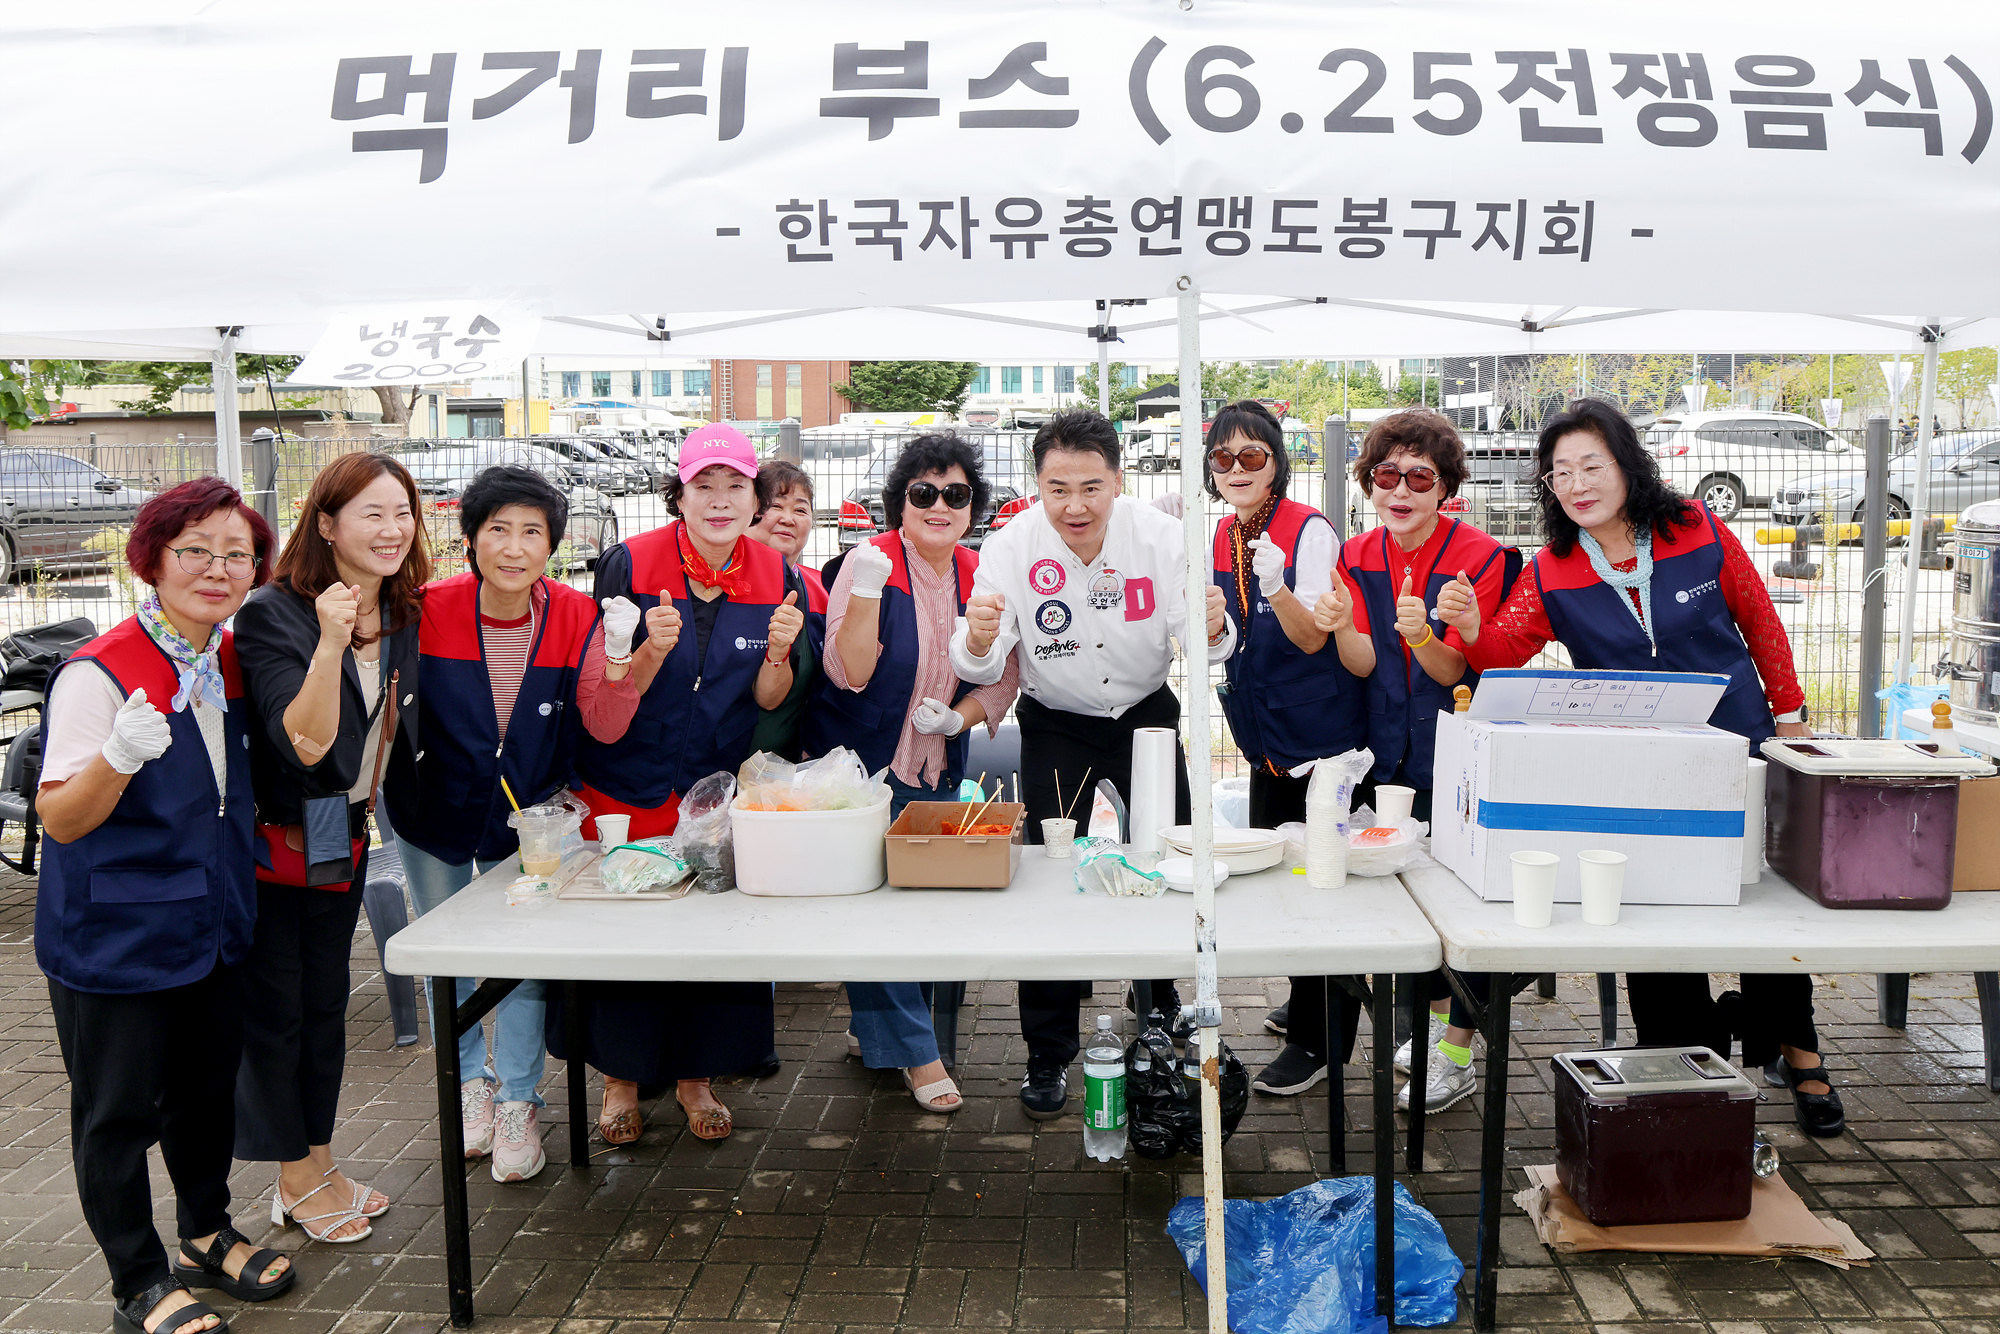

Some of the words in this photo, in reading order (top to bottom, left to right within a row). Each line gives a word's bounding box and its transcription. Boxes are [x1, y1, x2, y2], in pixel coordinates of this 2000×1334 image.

[332, 49, 748, 185] 먹거리
[820, 41, 1081, 143] 부스
[1129, 36, 1995, 165] (6.25전쟁음식)
[776, 195, 1596, 263] 한국자유총연맹도봉구지회
[360, 314, 502, 361] 냉국수
[333, 362, 488, 382] 2000
[702, 438, 730, 449] NYC
[1124, 576, 1156, 622] D
[1034, 639, 1077, 656] DOBONG
